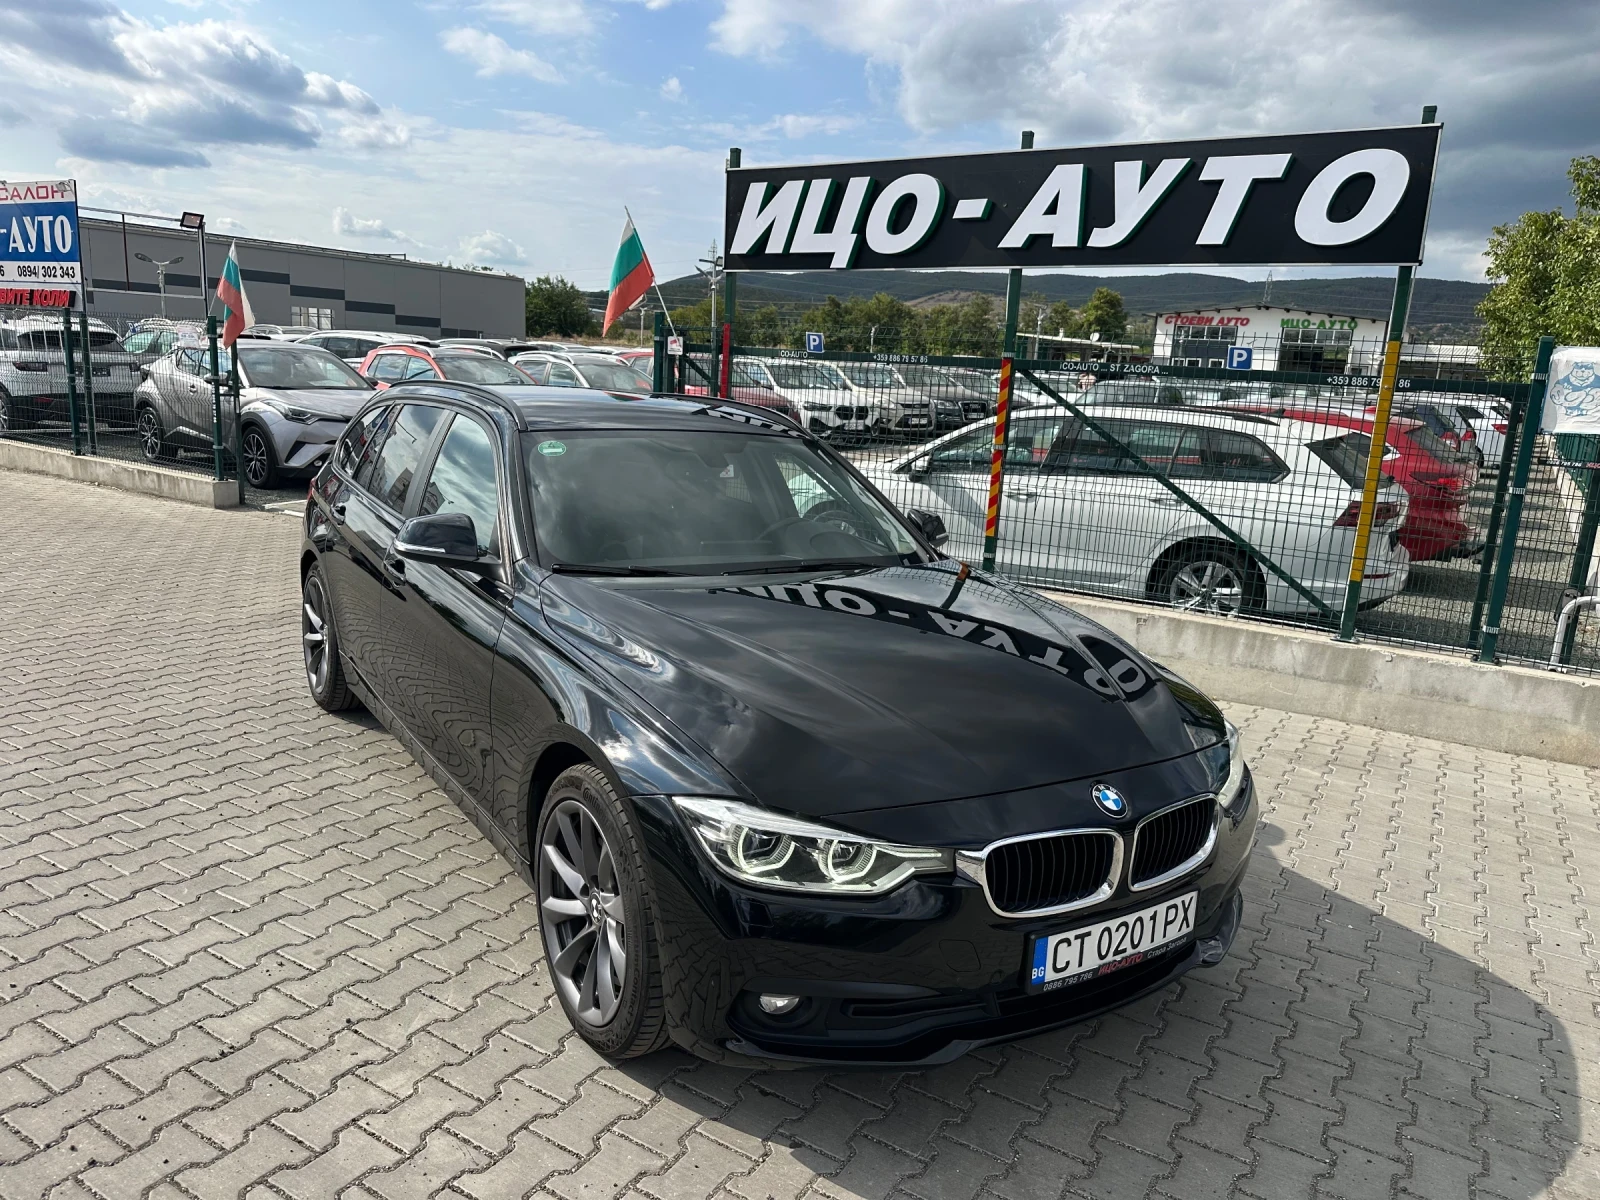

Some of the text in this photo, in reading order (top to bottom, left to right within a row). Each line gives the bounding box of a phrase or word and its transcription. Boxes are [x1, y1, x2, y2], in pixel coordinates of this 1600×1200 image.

[42, 266, 57, 278] 302
[60, 266, 76, 279] 343
[32, 289, 71, 307] КОЛИ
[1165, 315, 1250, 327] СТОЕВИ АУТО
[1280, 318, 1359, 330] ИЦО-АУТО
[1232, 350, 1248, 367] P
[1123, 364, 1160, 374] ZAGORA
[1326, 376, 1349, 385] +359
[1351, 377, 1368, 386] 886
[1399, 379, 1411, 388] 86
[1097, 910, 1158, 961] 0201
[1032, 966, 1045, 980] BG
[1043, 980, 1062, 992] 0886
[1063, 976, 1079, 987] 795
[1079, 971, 1094, 983] 786
